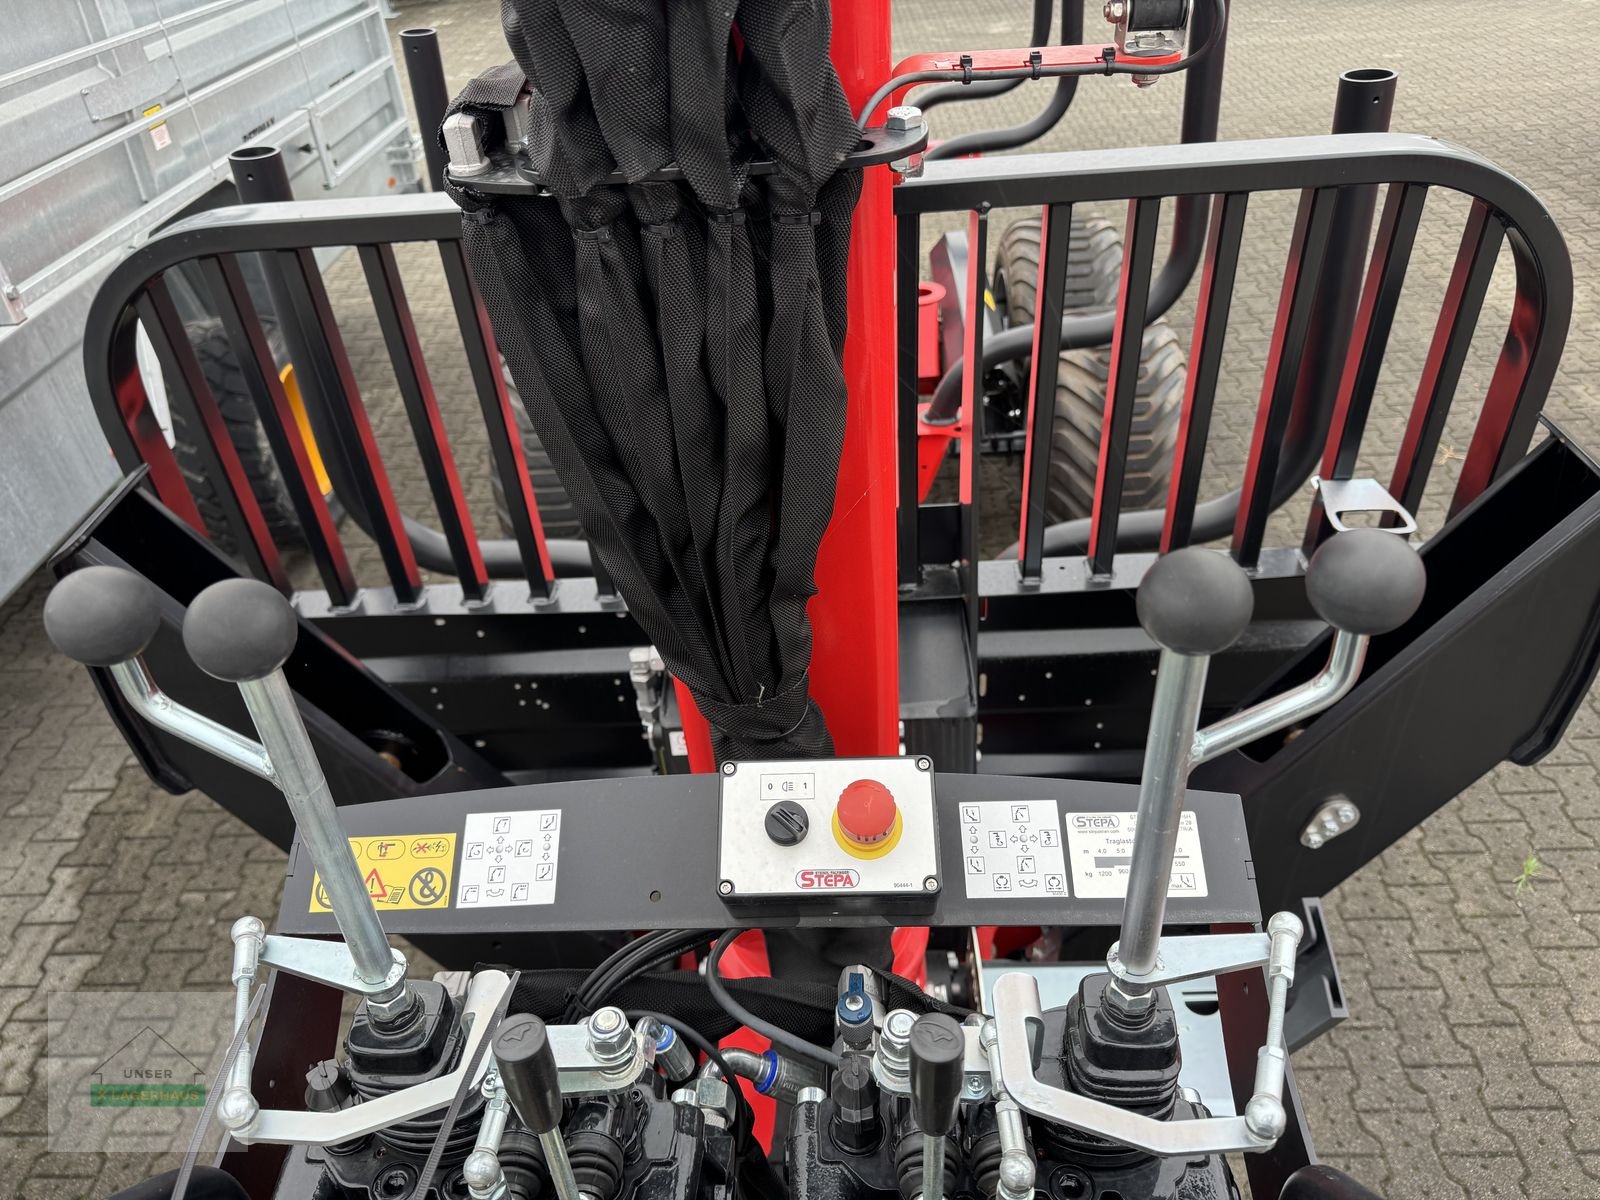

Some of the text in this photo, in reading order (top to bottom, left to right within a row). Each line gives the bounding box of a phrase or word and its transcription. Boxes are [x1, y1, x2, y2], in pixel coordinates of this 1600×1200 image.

[803, 782, 807, 790] 1
[1076, 815, 1116, 828] STEPA
[801, 871, 854, 888] STEPA
